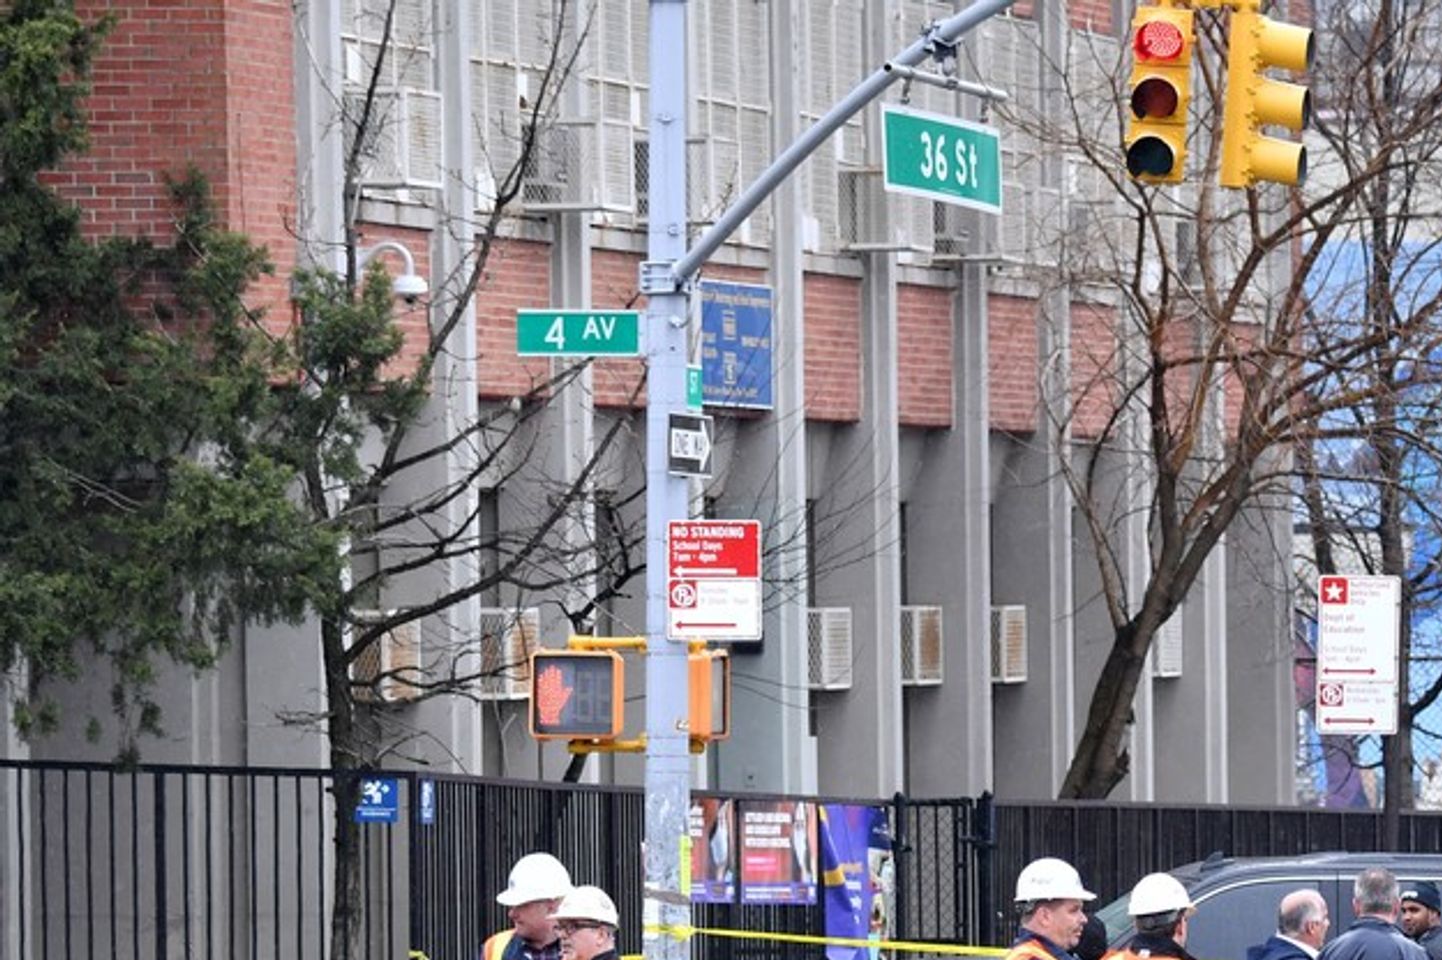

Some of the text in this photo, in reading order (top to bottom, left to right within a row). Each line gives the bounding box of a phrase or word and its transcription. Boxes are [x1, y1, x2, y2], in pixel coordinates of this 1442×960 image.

[919, 130, 978, 188] 36 St
[544, 316, 617, 350] 4 AV
[671, 526, 745, 539] NO STANDING
[672, 541, 724, 552] School Days
[698, 553, 718, 563] 4pm
[1324, 625, 1365, 634] Education
